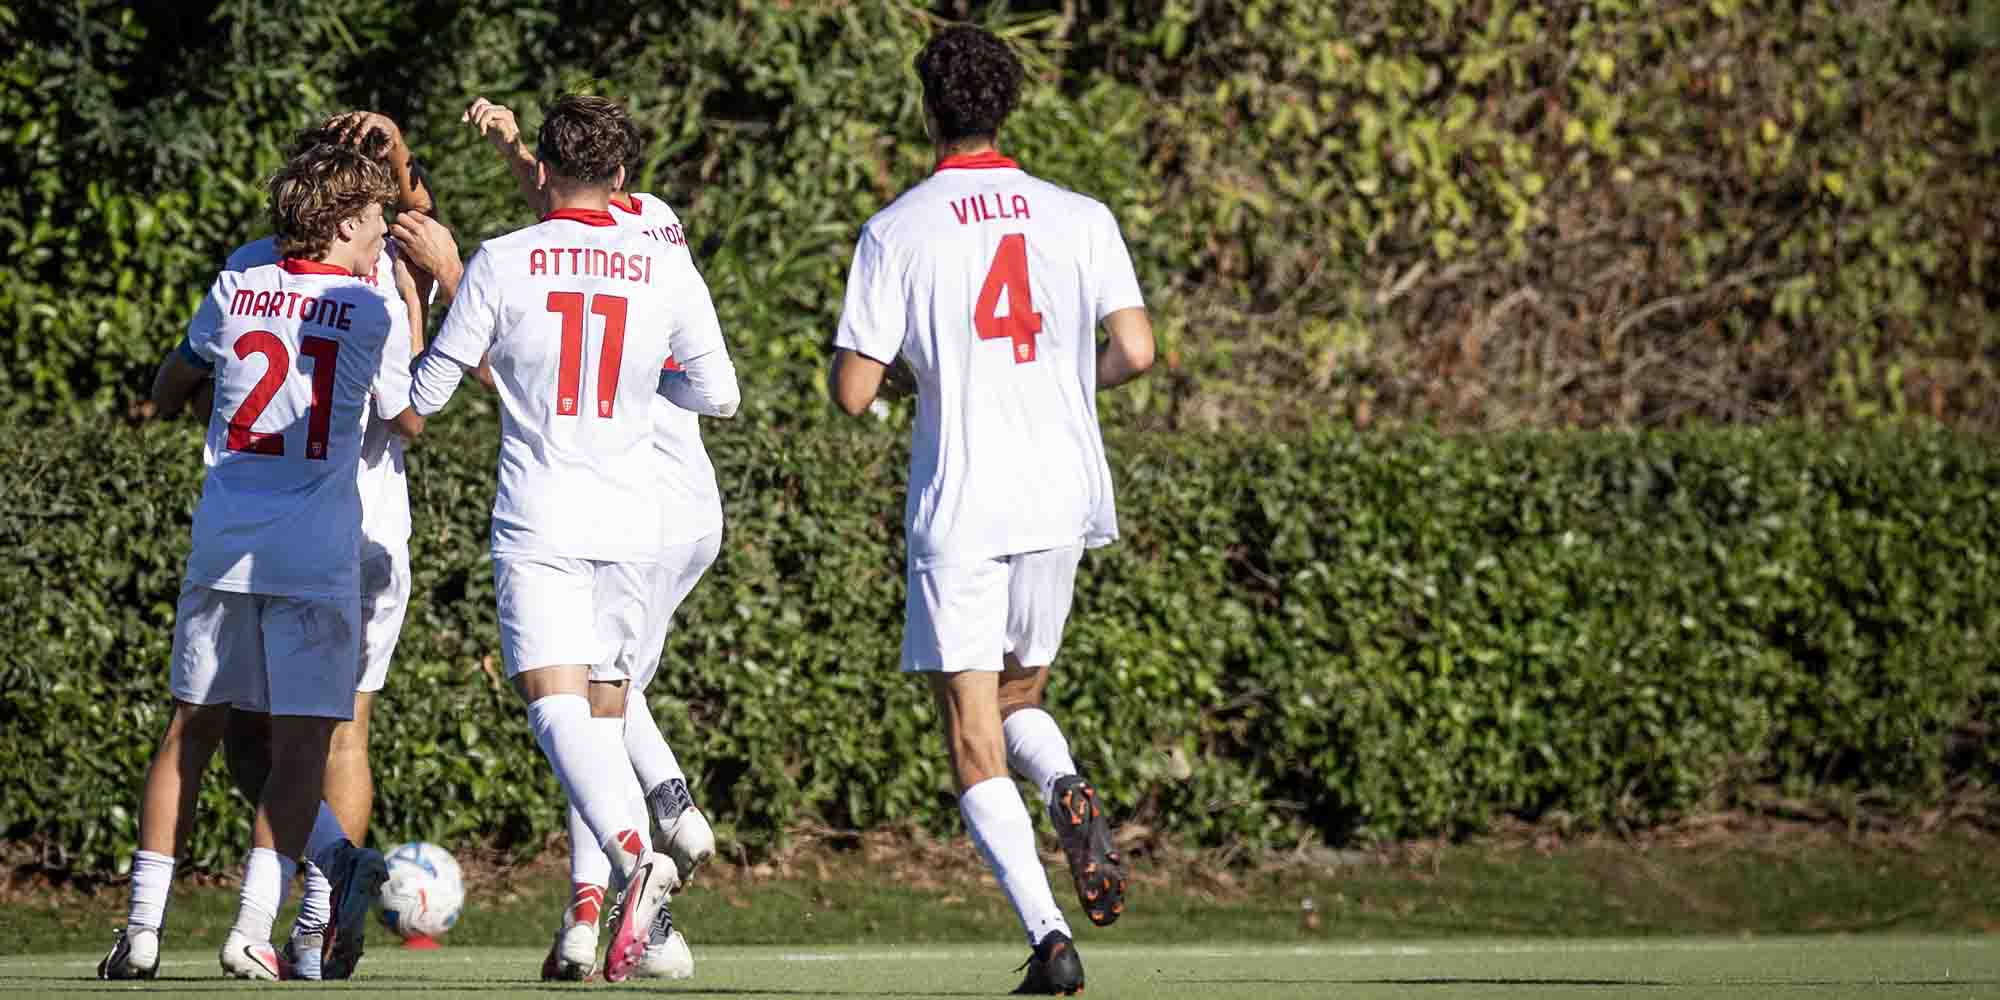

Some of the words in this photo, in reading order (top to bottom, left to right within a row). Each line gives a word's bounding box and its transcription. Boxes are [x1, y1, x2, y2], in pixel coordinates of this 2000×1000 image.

[950, 193, 1030, 224] VILLA
[530, 248, 651, 284] ATTINASI
[974, 233, 1042, 364] 4
[230, 289, 356, 331] MARTONE
[226, 330, 339, 460] 21
[546, 291, 628, 419] 11
